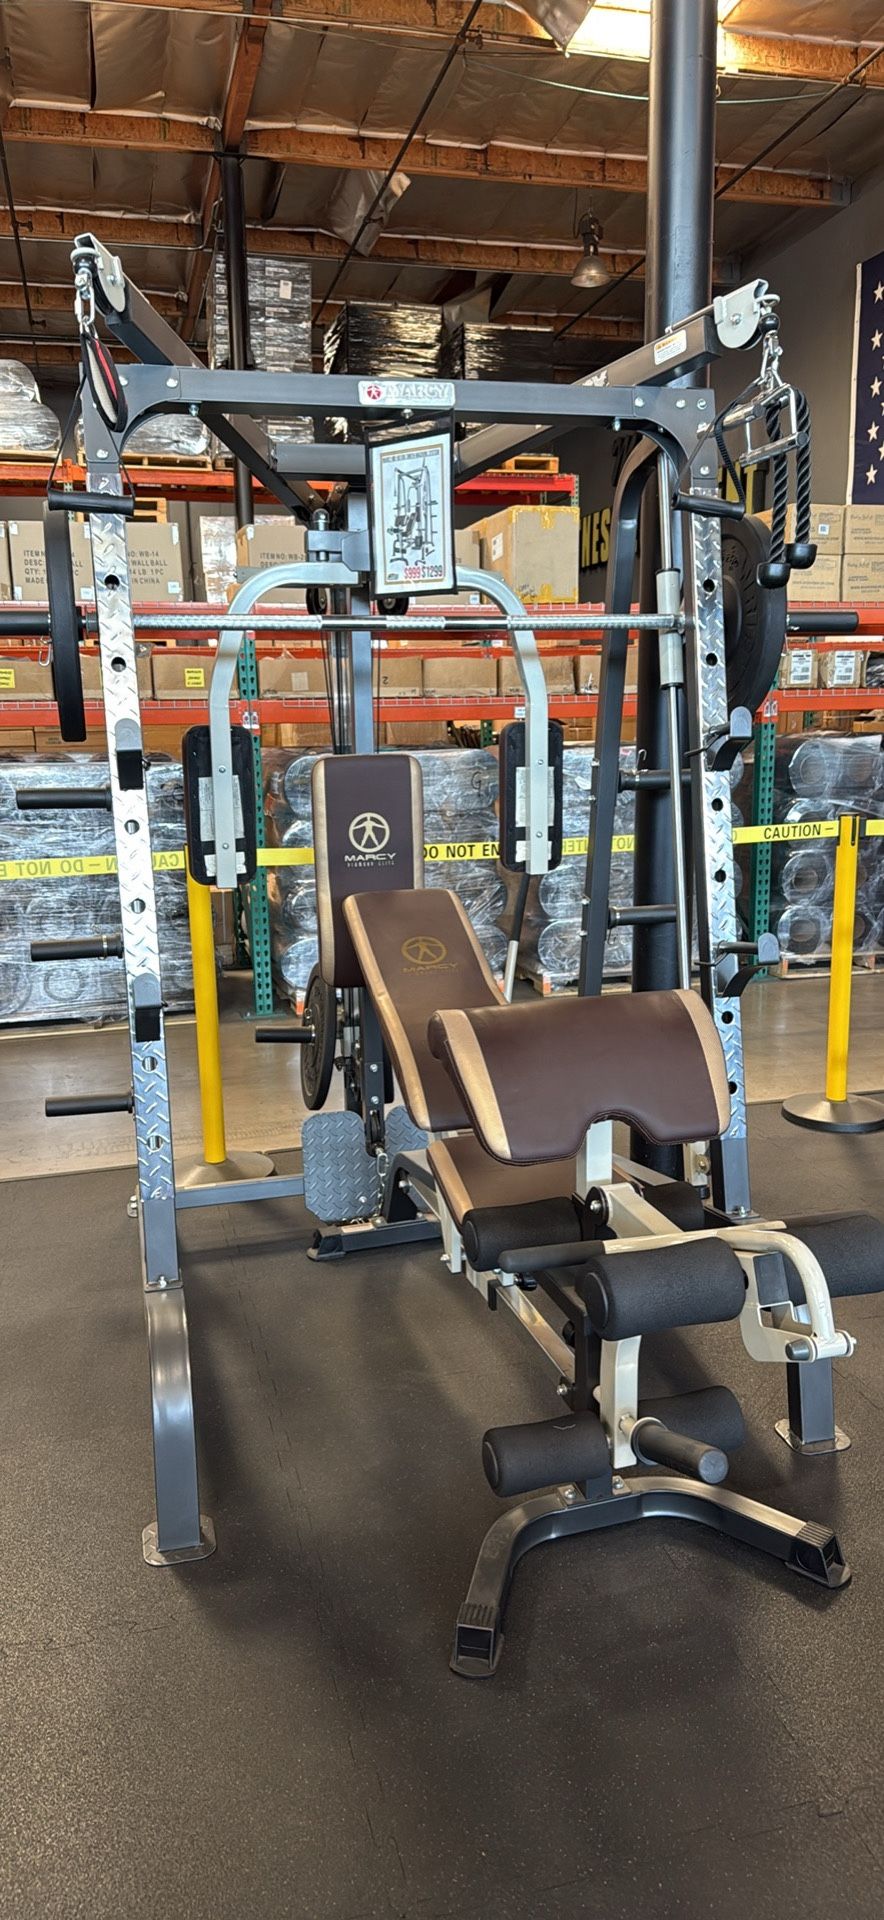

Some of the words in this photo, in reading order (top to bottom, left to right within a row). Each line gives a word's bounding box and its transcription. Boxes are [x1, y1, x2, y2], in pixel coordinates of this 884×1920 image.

[385, 383, 448, 398] MARCY
[404, 566, 421, 579] $999
[422, 565, 443, 578] $1299
[763, 824, 822, 840] CAUTION
[344, 852, 396, 862] MARCY
[446, 844, 476, 858] NOT
